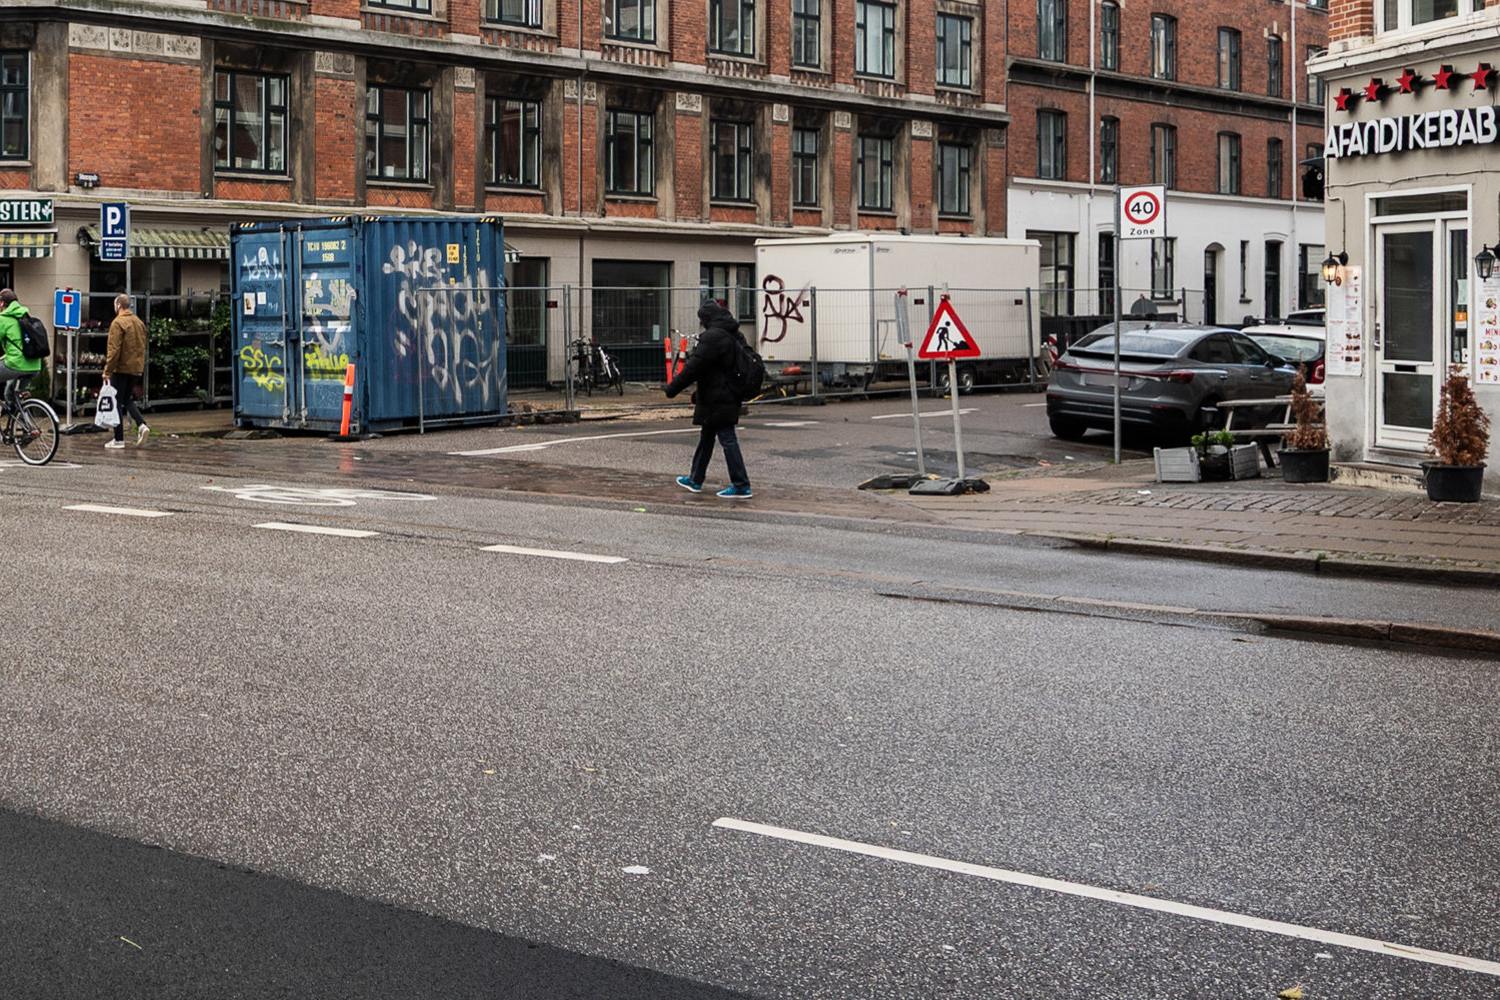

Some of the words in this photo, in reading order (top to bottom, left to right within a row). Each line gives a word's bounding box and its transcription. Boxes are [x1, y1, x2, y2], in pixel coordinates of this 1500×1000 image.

[1324, 115, 1403, 158] AFANDI
[1409, 105, 1497, 149] KEBAB
[107, 206, 121, 235] P
[1131, 201, 1154, 214] 40
